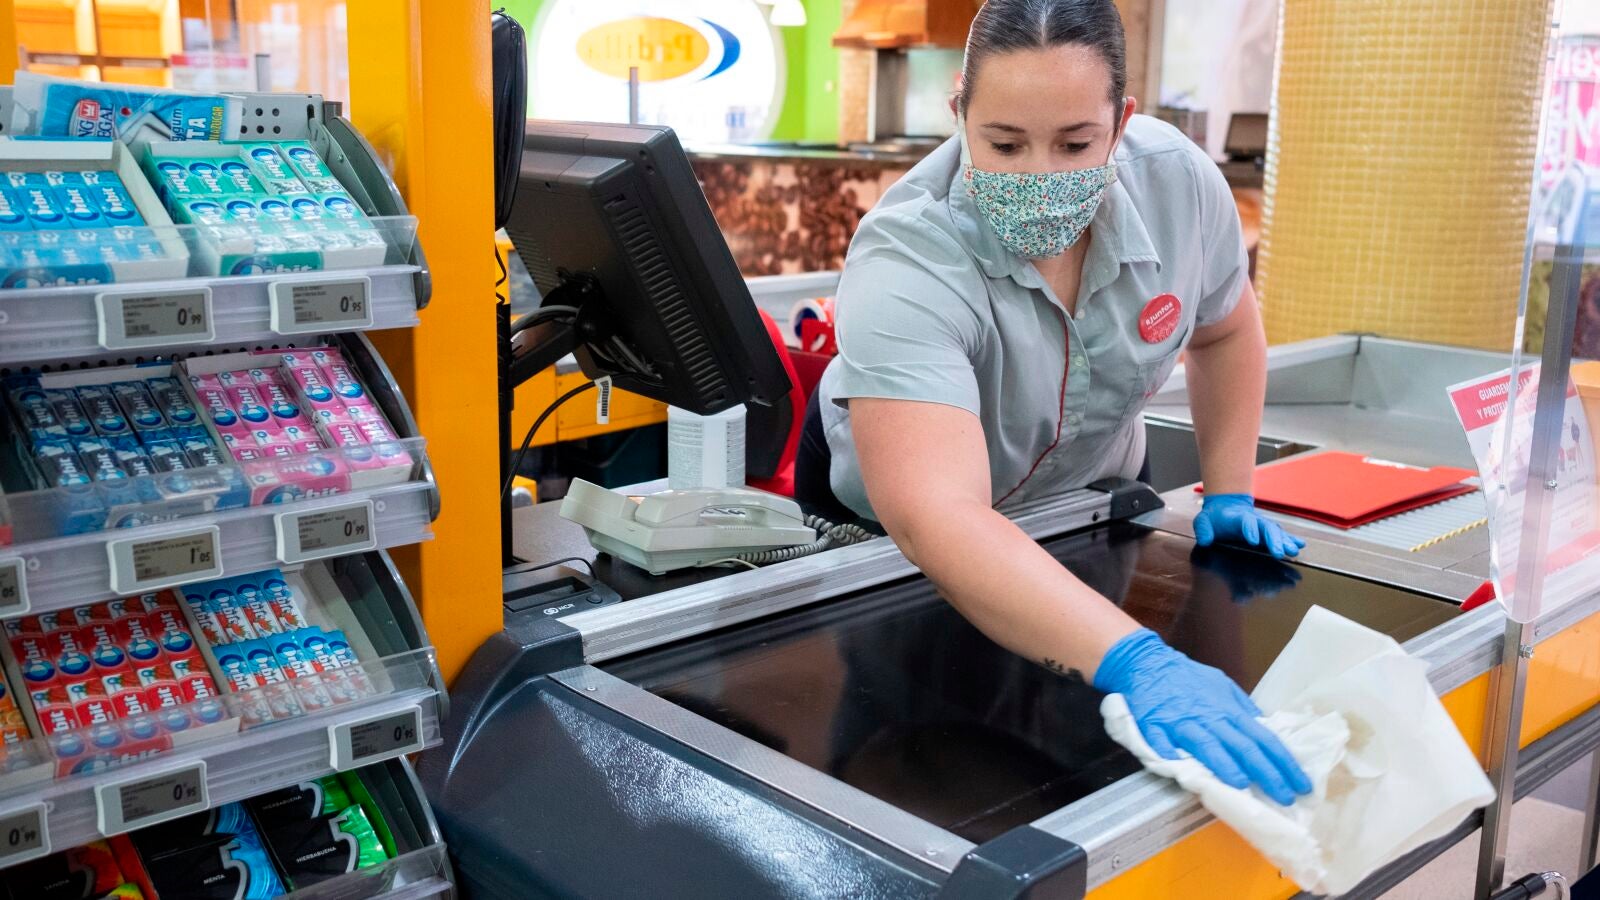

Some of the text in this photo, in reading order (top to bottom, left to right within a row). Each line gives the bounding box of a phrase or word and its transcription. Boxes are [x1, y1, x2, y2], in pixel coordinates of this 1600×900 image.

[78, 120, 95, 138] NG
[97, 104, 113, 138] EGAL
[186, 117, 206, 139] TA
[296, 846, 337, 863] HIERBABUENA
[328, 815, 359, 873] 5
[203, 874, 225, 885] MENTA
[219, 840, 248, 900] 5
